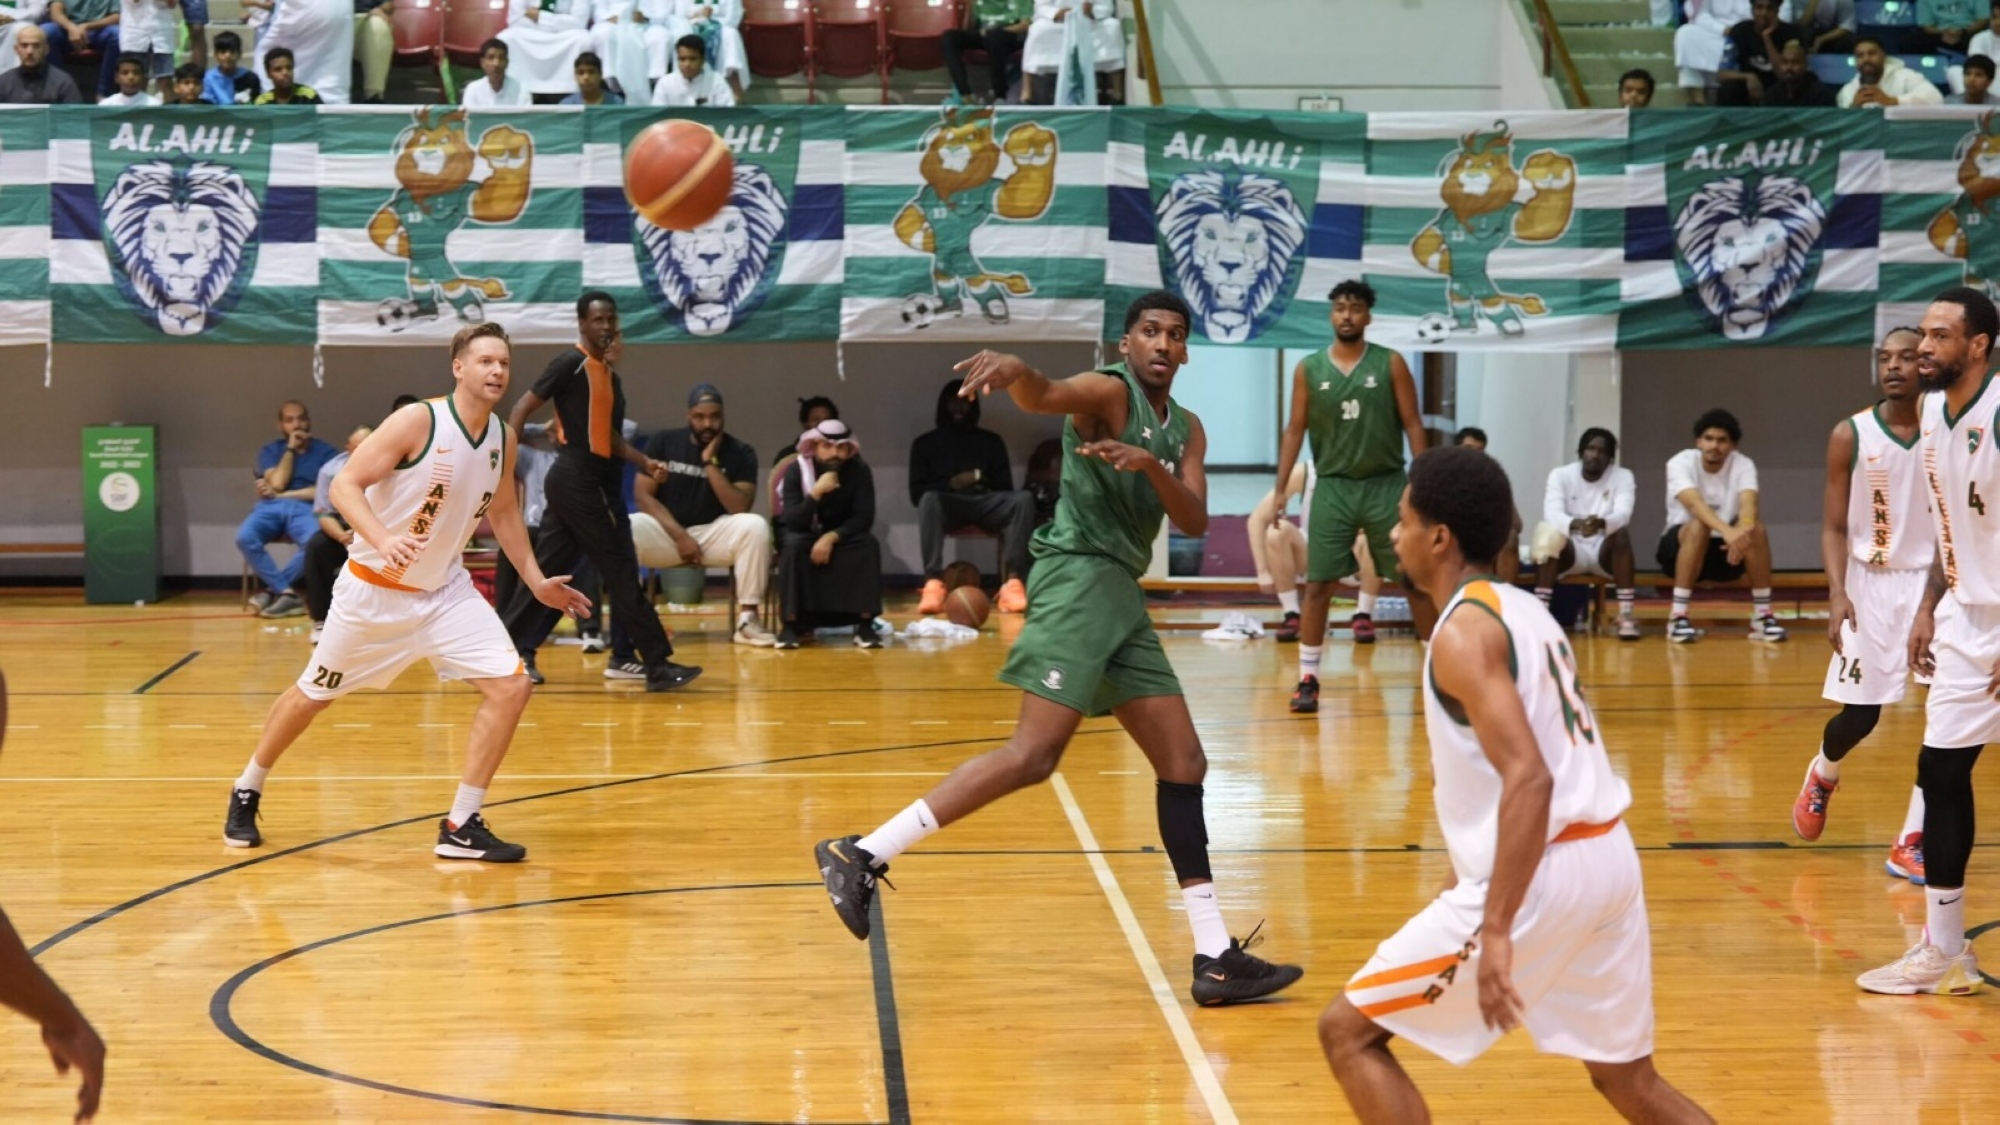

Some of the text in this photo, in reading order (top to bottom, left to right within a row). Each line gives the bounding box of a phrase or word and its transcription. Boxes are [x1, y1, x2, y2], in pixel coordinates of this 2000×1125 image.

[1341, 399, 1360, 420] 20
[412, 483, 444, 535] ANS
[473, 491, 492, 519] 2
[1968, 480, 1985, 516] 4
[1868, 488, 1888, 566] ANSA
[312, 664, 343, 690] 20
[1838, 655, 1863, 685] 24
